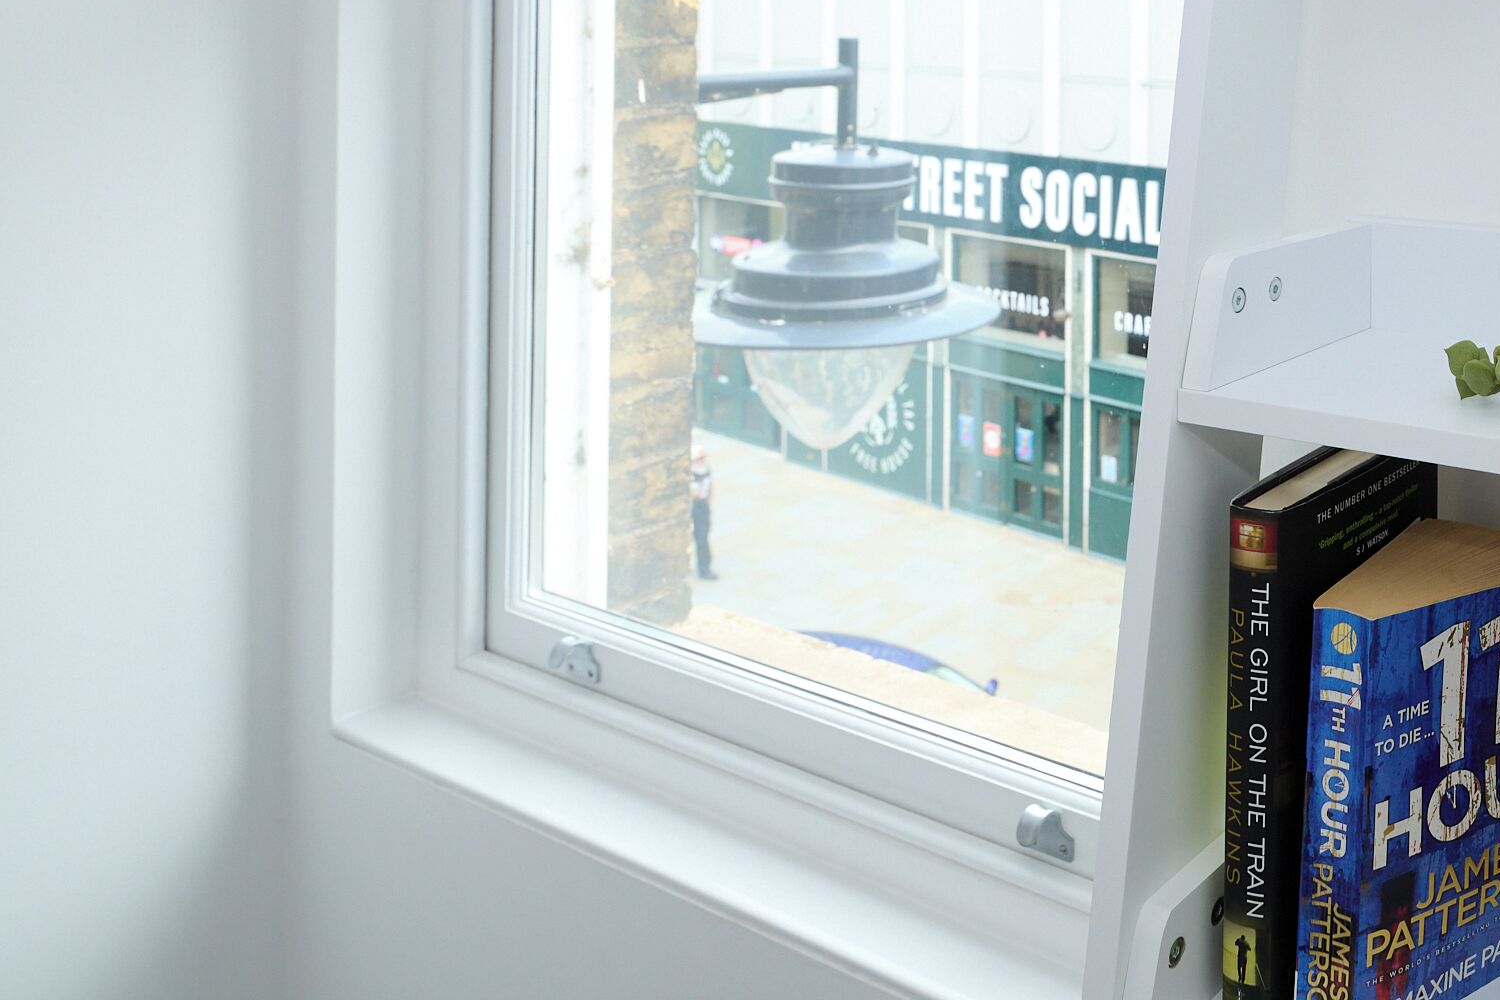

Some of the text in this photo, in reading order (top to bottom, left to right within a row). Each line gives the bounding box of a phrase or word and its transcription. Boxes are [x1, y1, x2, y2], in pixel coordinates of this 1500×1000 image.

[1019, 166, 1161, 246] SOCIAL
[975, 285, 1050, 318] KTAILS
[1316, 507, 1332, 524] THE
[1334, 489, 1366, 515] NUMBER
[1367, 480, 1382, 496] ONE
[1356, 529, 1389, 556] S J WATSON
[1225, 608, 1245, 885] PAULA HAWKINS
[1374, 738, 1395, 757] TO
[1383, 700, 1430, 730] A TIME
[1246, 583, 1270, 918] THE GIRL ON THE TRAIN
[1319, 739, 1351, 859] HOUR
[1328, 903, 1352, 1000] JAMES
[1365, 975, 1384, 988] THE
[1435, 921, 1490, 956] BESTSELLING
